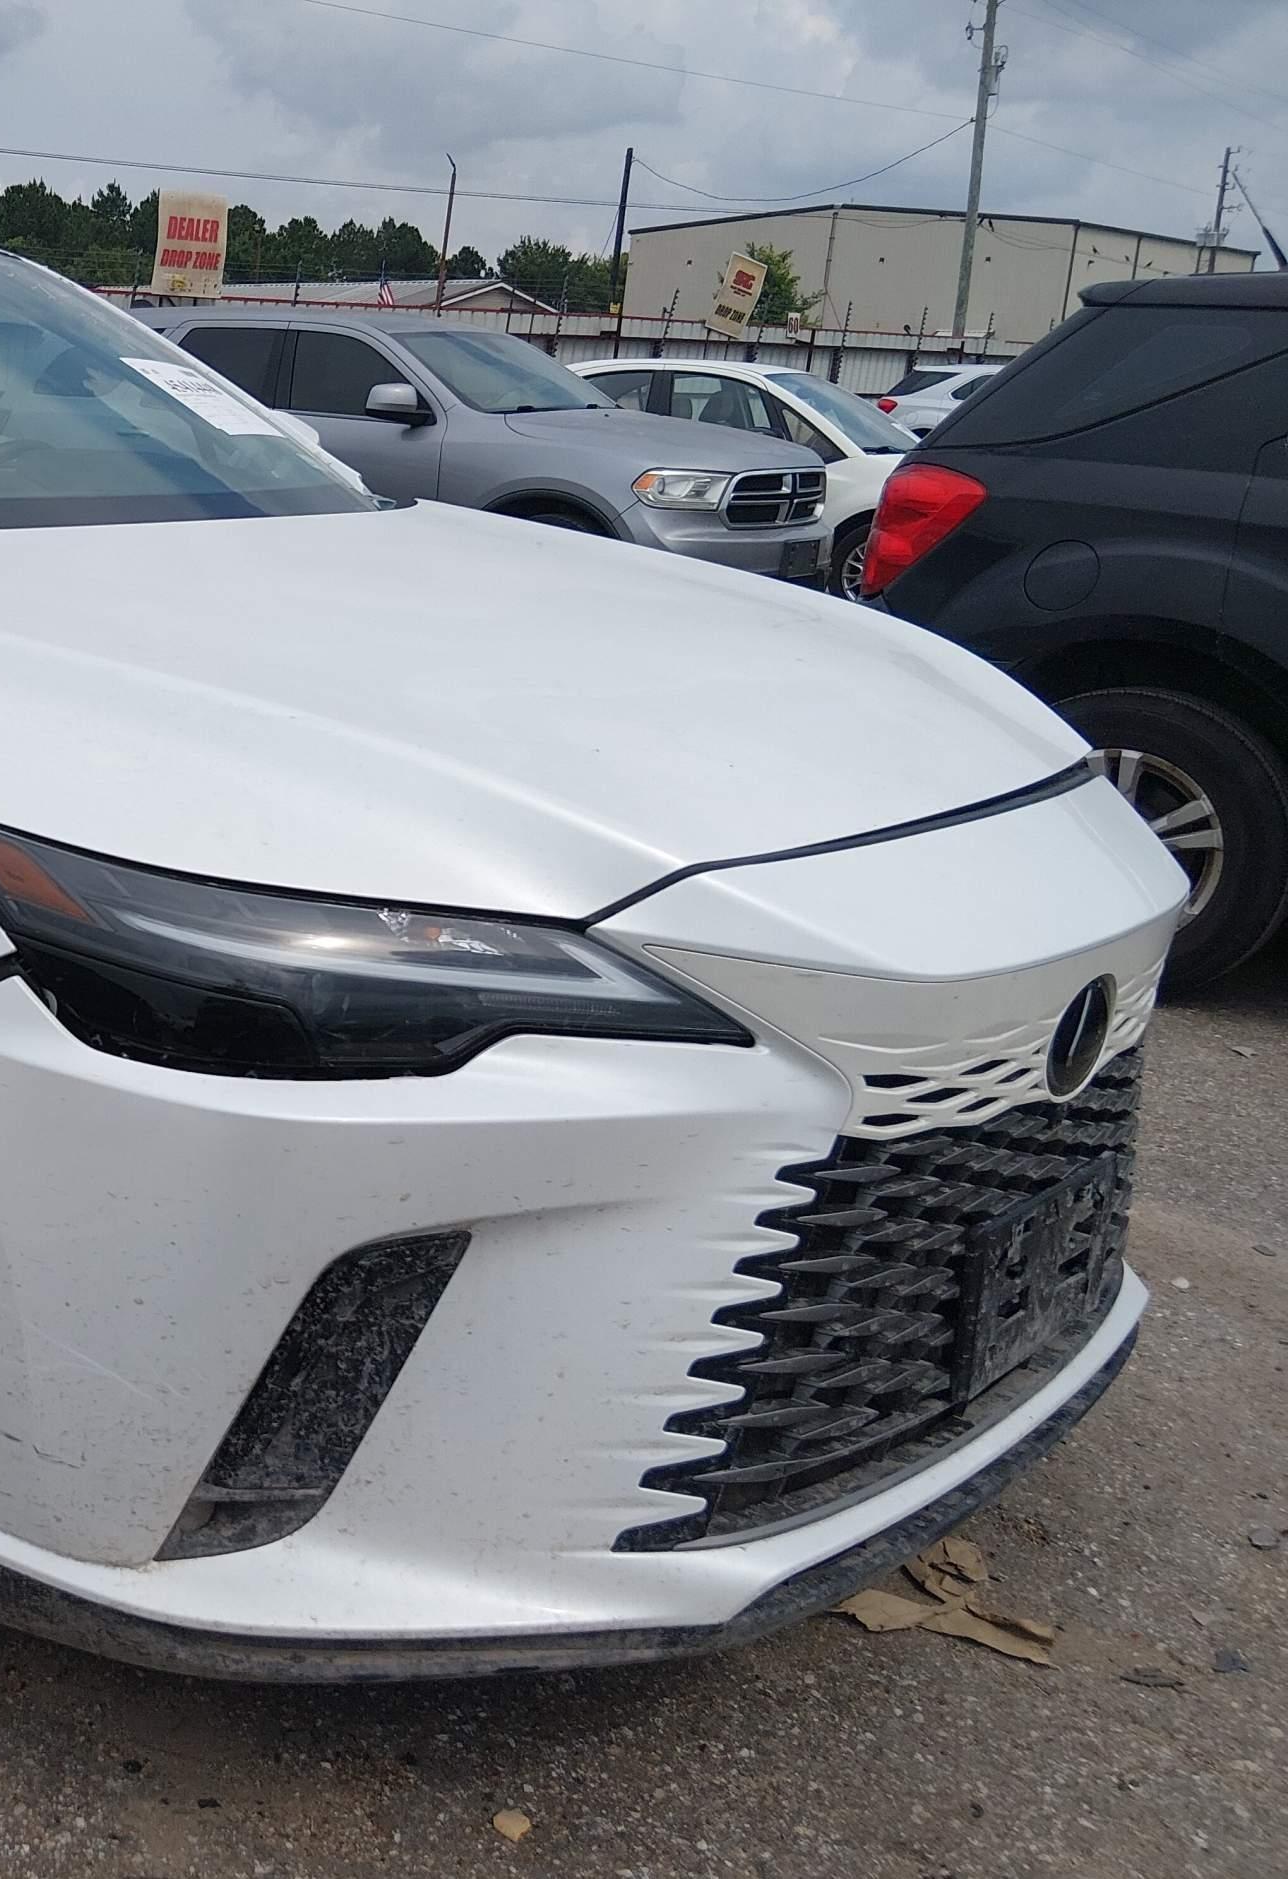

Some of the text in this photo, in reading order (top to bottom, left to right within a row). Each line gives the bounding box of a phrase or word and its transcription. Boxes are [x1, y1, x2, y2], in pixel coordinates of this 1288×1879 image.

[167, 216, 219, 243] DEALER
[160, 249, 221, 271] DROP ZONE
[715, 303, 746, 324] DROP ZONE
[788, 317, 799, 334] 60
